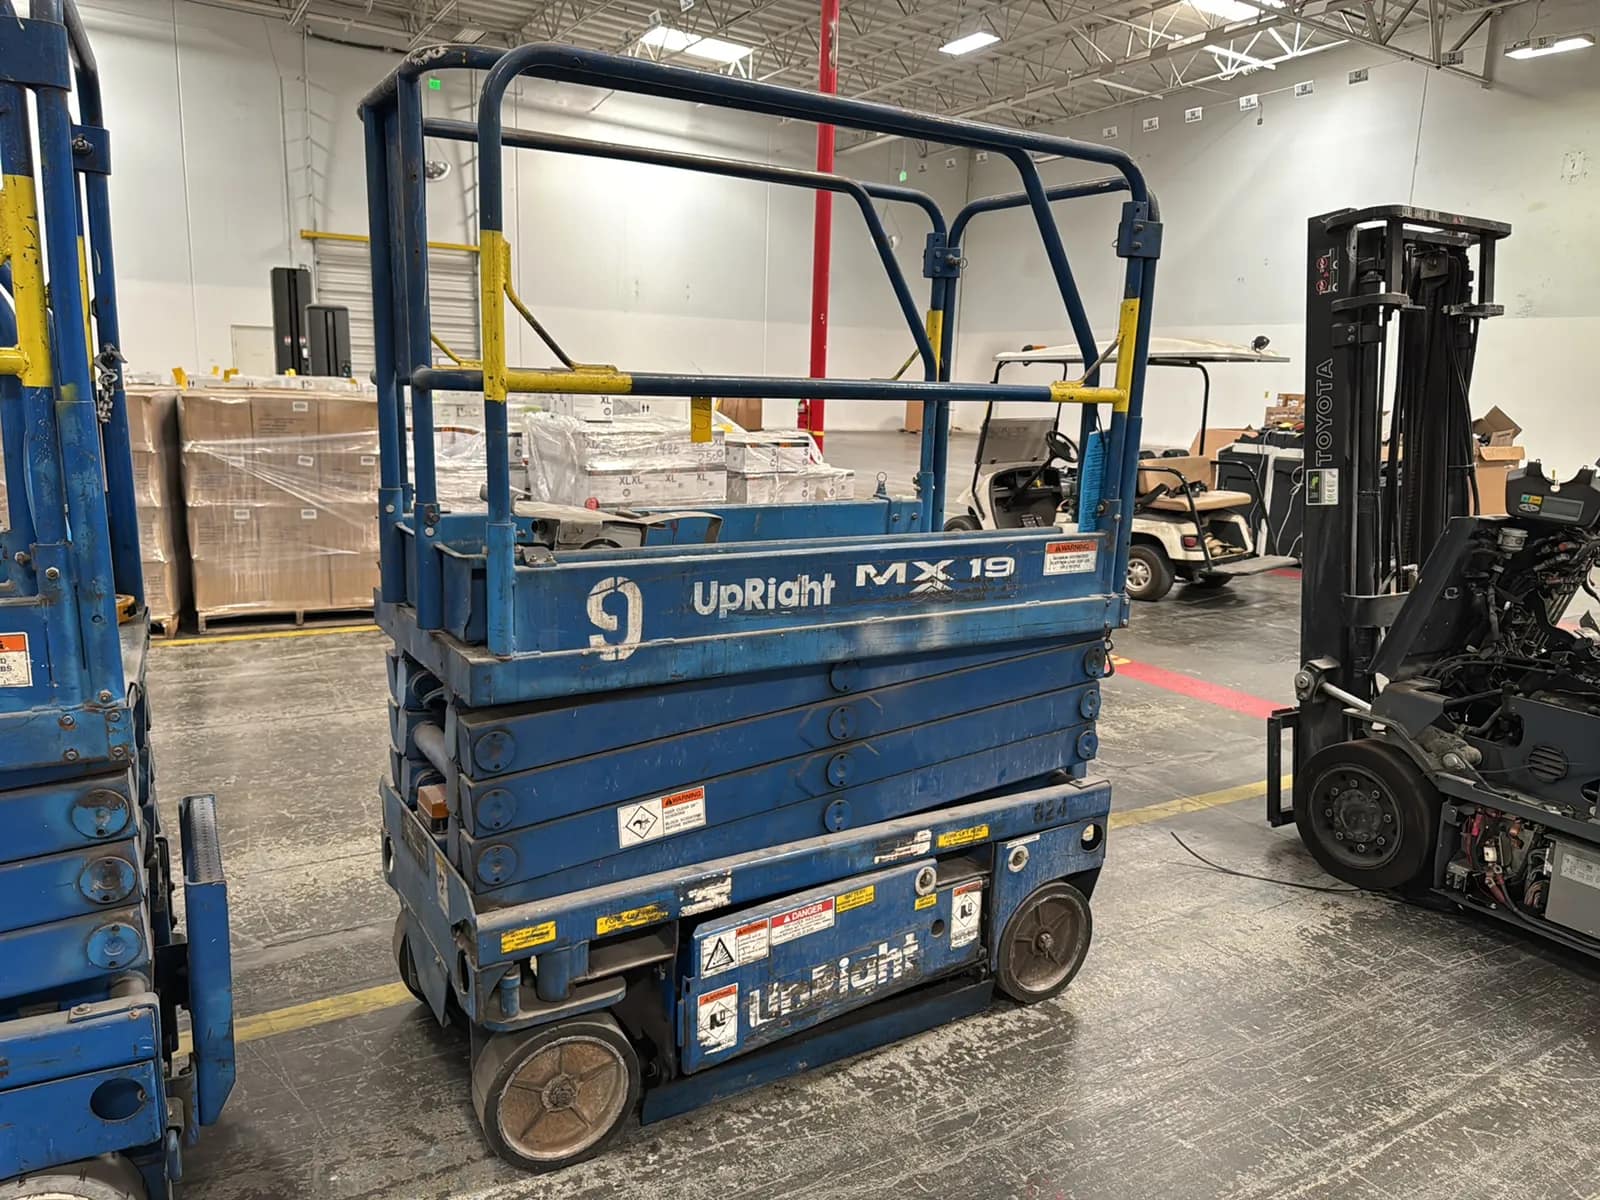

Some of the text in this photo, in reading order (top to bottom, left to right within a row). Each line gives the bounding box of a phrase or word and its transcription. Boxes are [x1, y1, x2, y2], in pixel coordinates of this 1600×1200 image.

[1315, 358, 1334, 467] TOYOTA
[665, 474, 677, 483] XL
[696, 472, 708, 481] XL
[855, 559, 955, 594] MX
[968, 556, 1016, 579] 19
[693, 573, 836, 619] UpRight
[586, 576, 643, 662] 9
[672, 789, 702, 803] WARNING
[791, 903, 824, 921] DANGER
